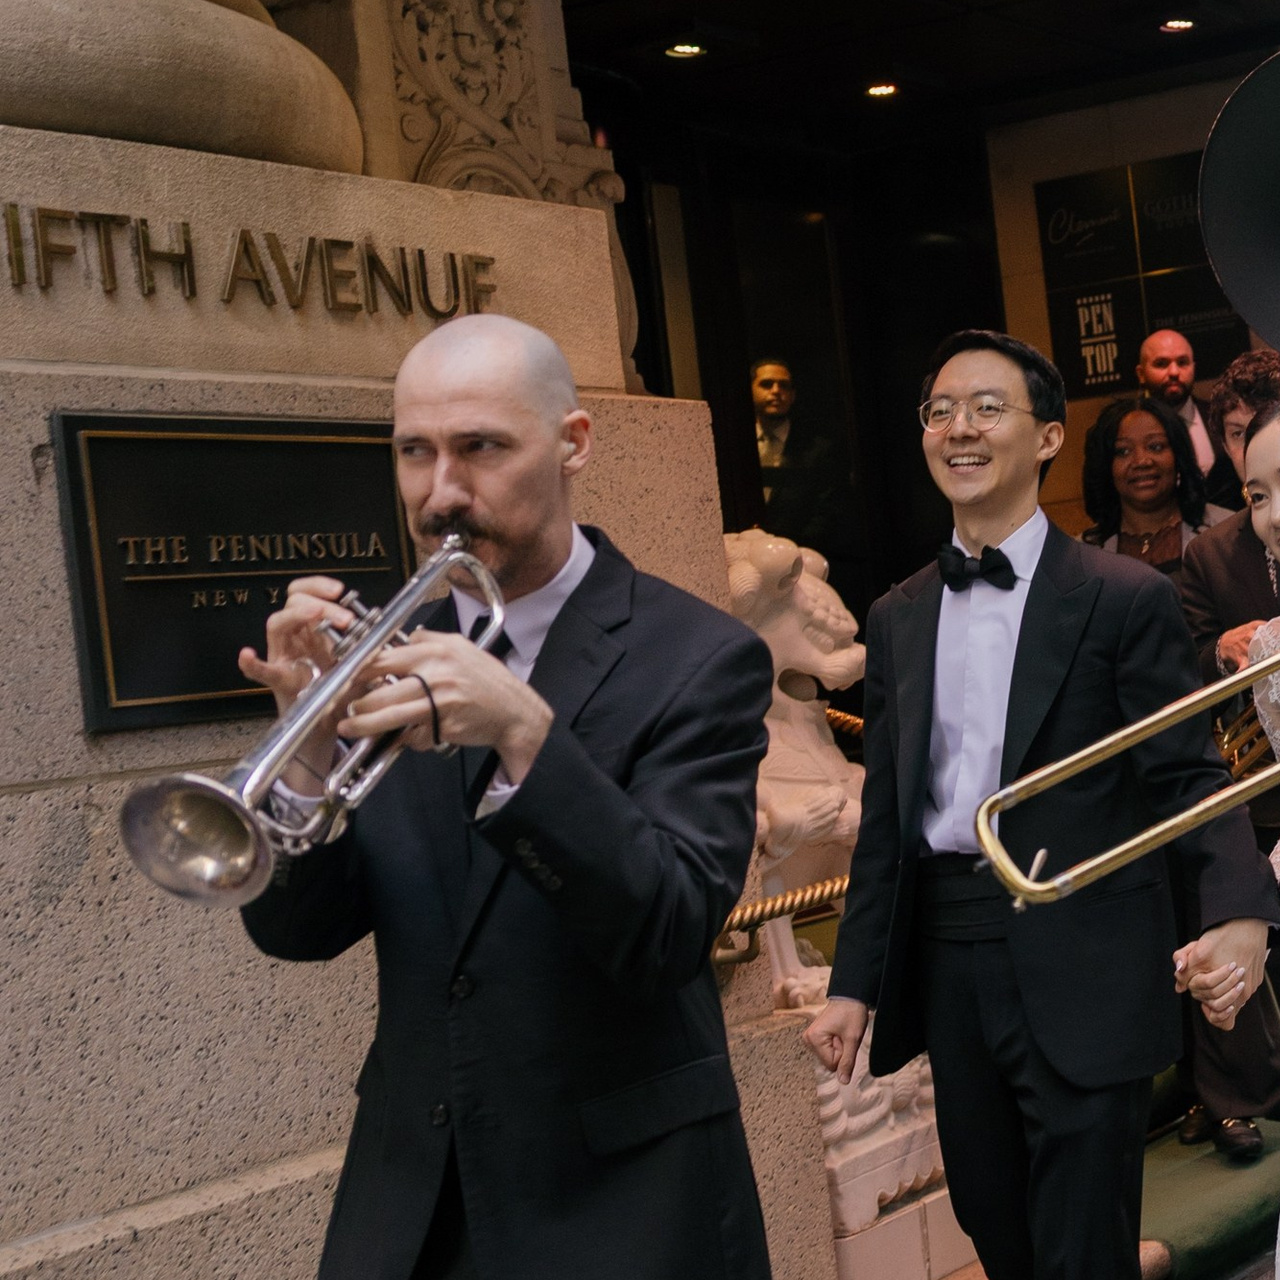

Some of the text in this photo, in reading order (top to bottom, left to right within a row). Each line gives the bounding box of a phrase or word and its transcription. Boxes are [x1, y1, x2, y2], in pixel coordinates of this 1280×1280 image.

[1077, 302, 1114, 337] PEN
[1080, 341, 1119, 376] TOP
[117, 531, 387, 565] THE PENINSULA
[191, 588, 249, 608] NEW
